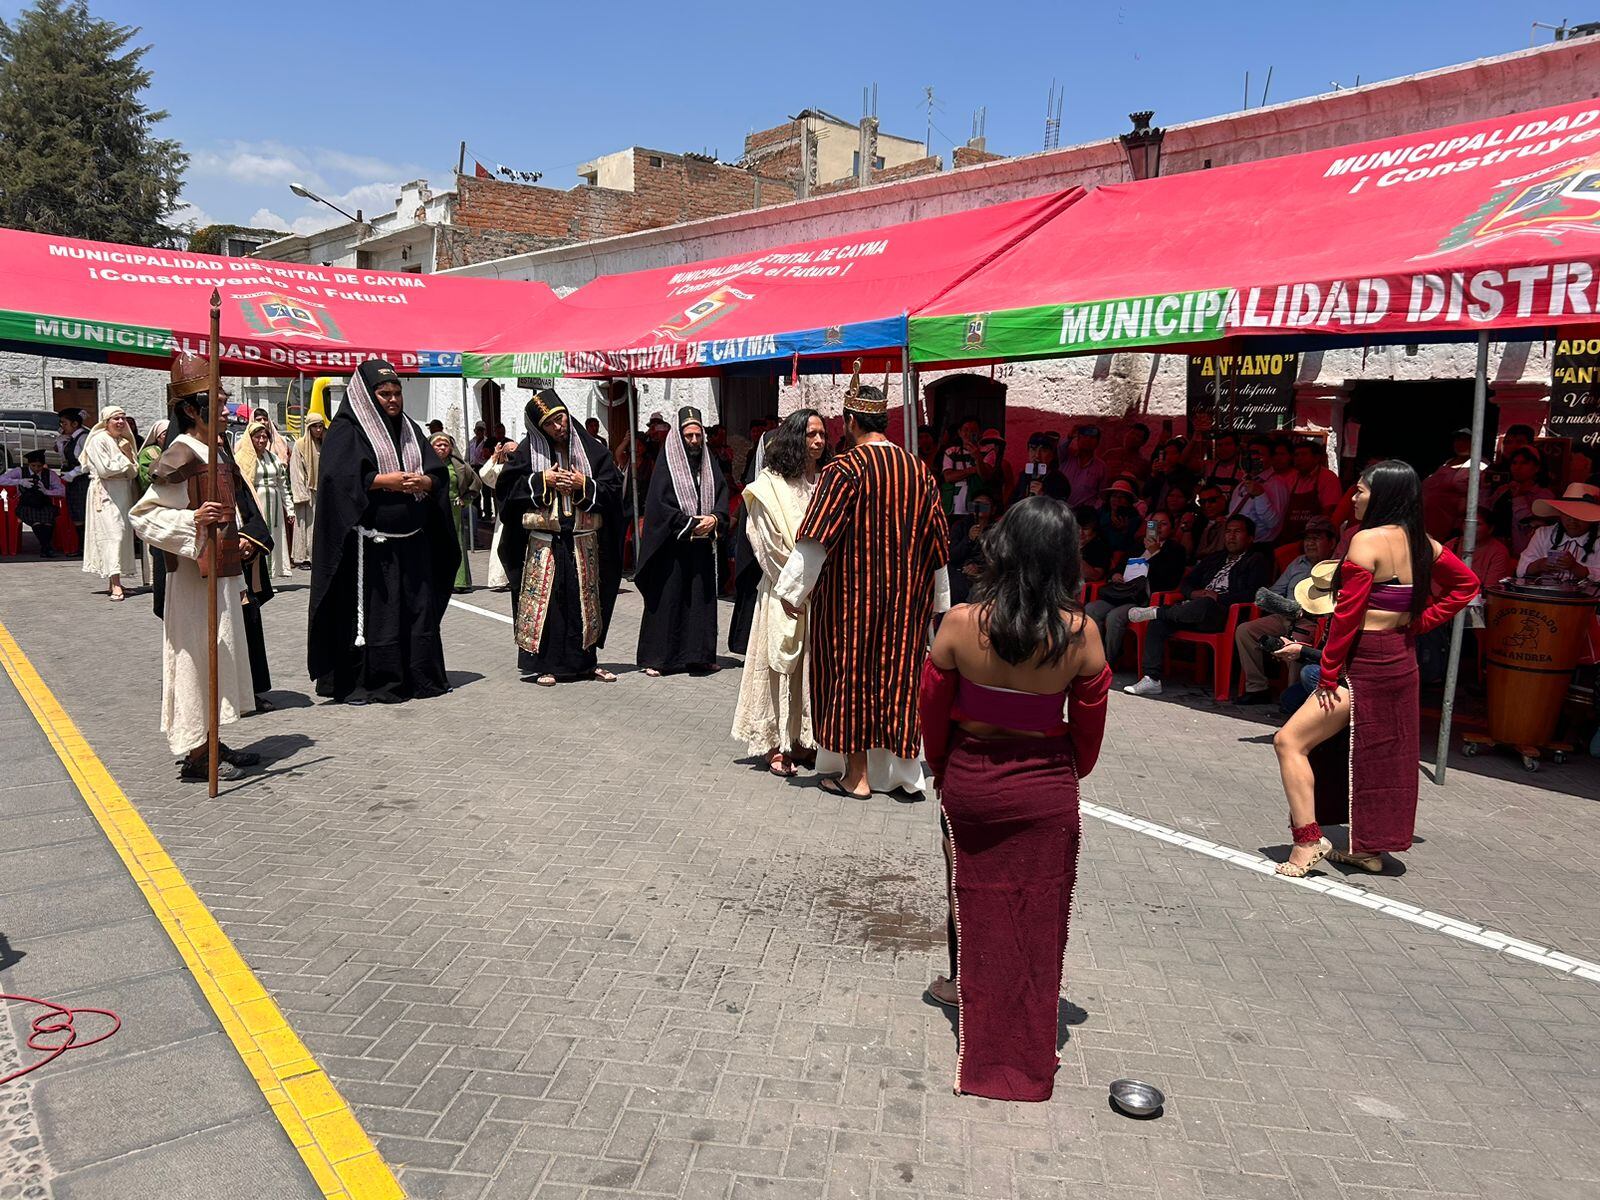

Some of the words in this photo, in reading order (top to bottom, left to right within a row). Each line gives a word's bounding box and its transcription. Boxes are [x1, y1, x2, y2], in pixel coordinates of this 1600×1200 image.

[1323, 109, 1600, 178] MUNICIPALIDAD
[1376, 128, 1600, 188] Construye
[813, 248, 839, 262] DE
[836, 239, 889, 260] CAYMA
[49, 244, 224, 271] MUNICIPALIDAD
[229, 261, 331, 283] DISTRITAL
[334, 273, 360, 285] DE
[364, 275, 427, 288] CAYMA
[764, 266, 787, 277] el
[783, 265, 840, 277] Futuro
[296, 284, 319, 295] el
[323, 287, 409, 305] Futuro!
[1059, 277, 1391, 345] MUNICIPALIDAD
[1406, 262, 1600, 323] DISTR
[511, 350, 606, 375] MUNICIPALIDAD
[606, 342, 681, 372] DISTRITAL
[685, 340, 708, 365] DE
[712, 334, 776, 361] CAYMA
[1556, 339, 1600, 355] ADO
[402, 353, 431, 367] DE
[997, 365, 1014, 379] 312
[1239, 383, 1277, 400] disfruta
[1551, 414, 1565, 424] en
[1520, 608, 1559, 634] HELADO
